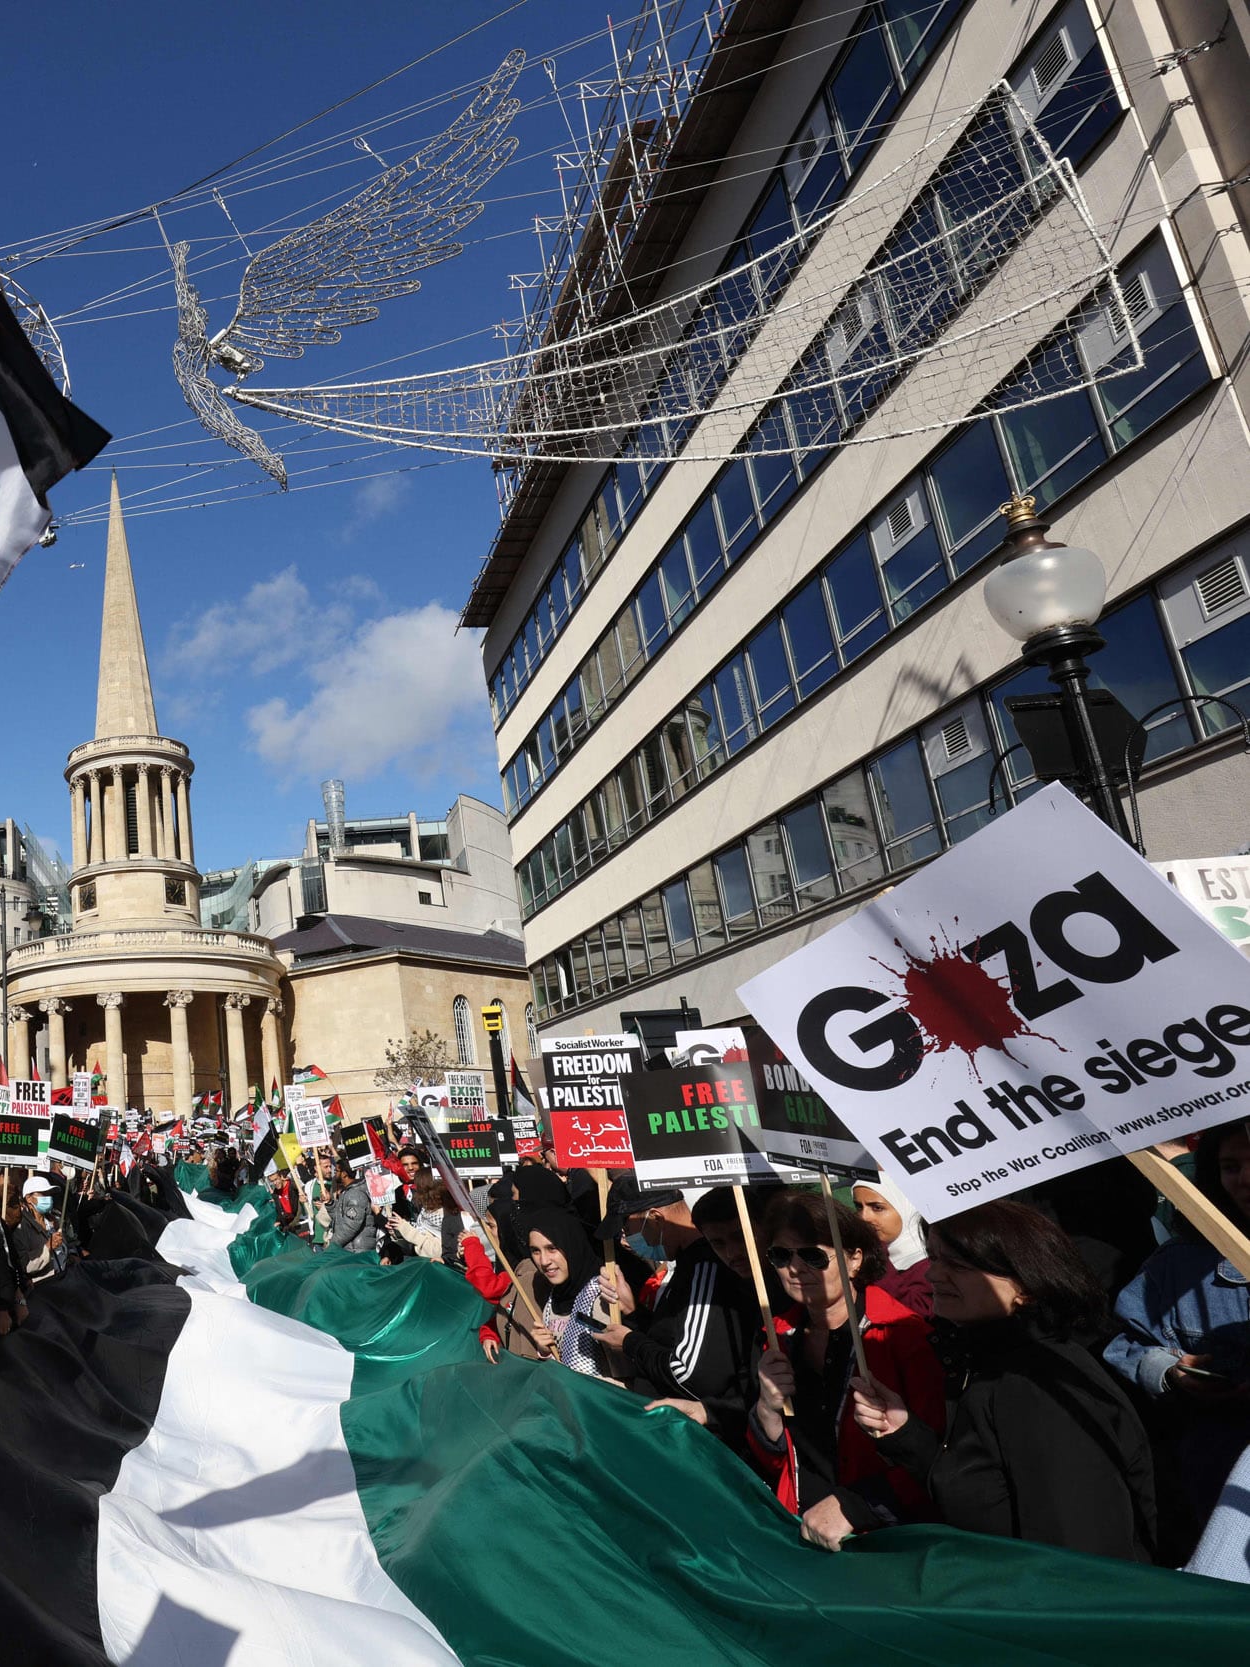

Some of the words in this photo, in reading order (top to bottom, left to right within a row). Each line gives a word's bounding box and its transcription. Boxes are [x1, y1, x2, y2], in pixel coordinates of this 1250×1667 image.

[552, 1052, 633, 1077] FREEDOM
[448, 1074, 460, 1084] FREE
[460, 1074, 482, 1086] PALESTINE
[587, 1075, 600, 1085] for
[15, 1081, 46, 1102] FREE
[450, 1086, 483, 1097] EXIST!
[552, 1085, 622, 1107] PALESTI
[681, 1079, 747, 1107] FREE
[879, 1100, 992, 1176] End
[986, 1074, 1086, 1131] the
[1084, 1004, 1250, 1095] siege
[11, 1101, 50, 1117] PALESTINE
[450, 1096, 484, 1106] RESIST!
[784, 1094, 828, 1126] GAZA
[467, 1123, 492, 1132] STOP
[648, 1104, 759, 1135] PALESTI
[0, 1122, 21, 1134] FREE
[68, 1125, 86, 1139] FREE
[56, 1131, 93, 1152] PALESTINE
[451, 1138, 475, 1149] FREE
[799, 1138, 813, 1154] FOA
[447, 1148, 492, 1159] ALESTINE
[704, 1158, 724, 1171] FOA
[726, 1157, 752, 1165] FRIENDS
[946, 1176, 982, 1197] Stop
[981, 1165, 1009, 1184] the
[1007, 1154, 1042, 1173] War
[1041, 1129, 1112, 1160] Coalition
